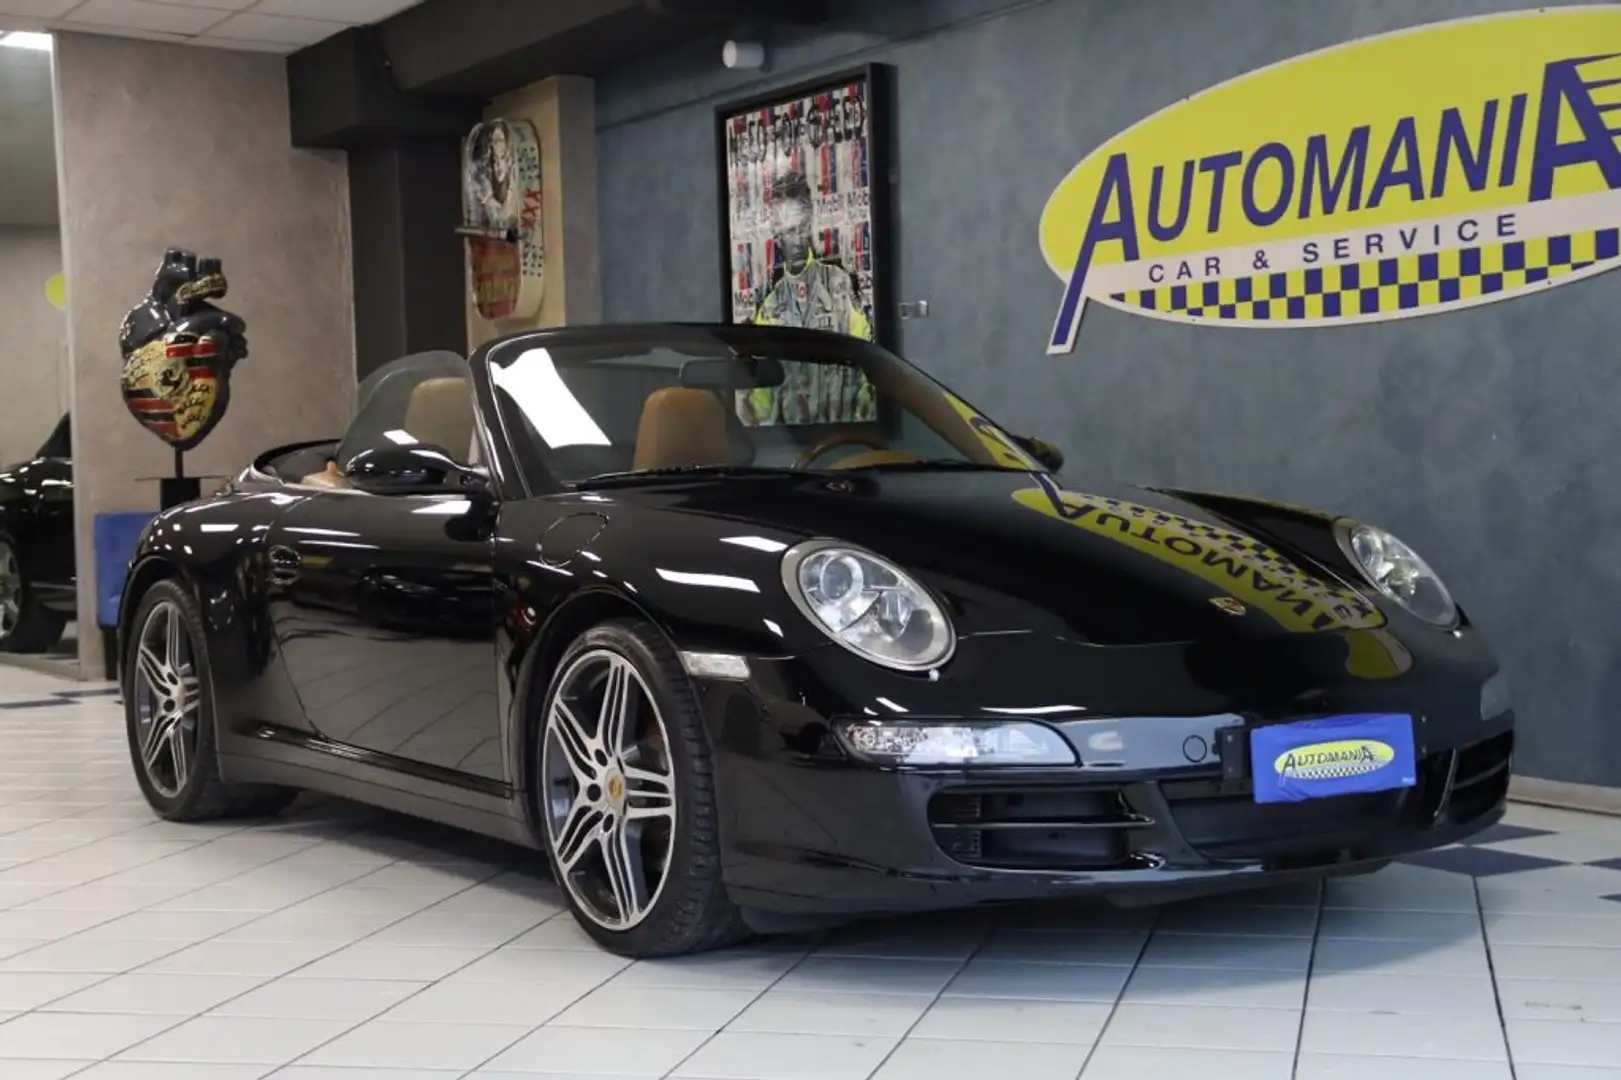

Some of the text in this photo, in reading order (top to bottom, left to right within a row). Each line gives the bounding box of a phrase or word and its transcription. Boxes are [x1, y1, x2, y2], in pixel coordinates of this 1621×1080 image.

[1051, 54, 1621, 346] AUTOMANIA
[1148, 213, 1517, 283] CAR & SERVICE
[1279, 745, 1374, 782] AUTOMANIA
